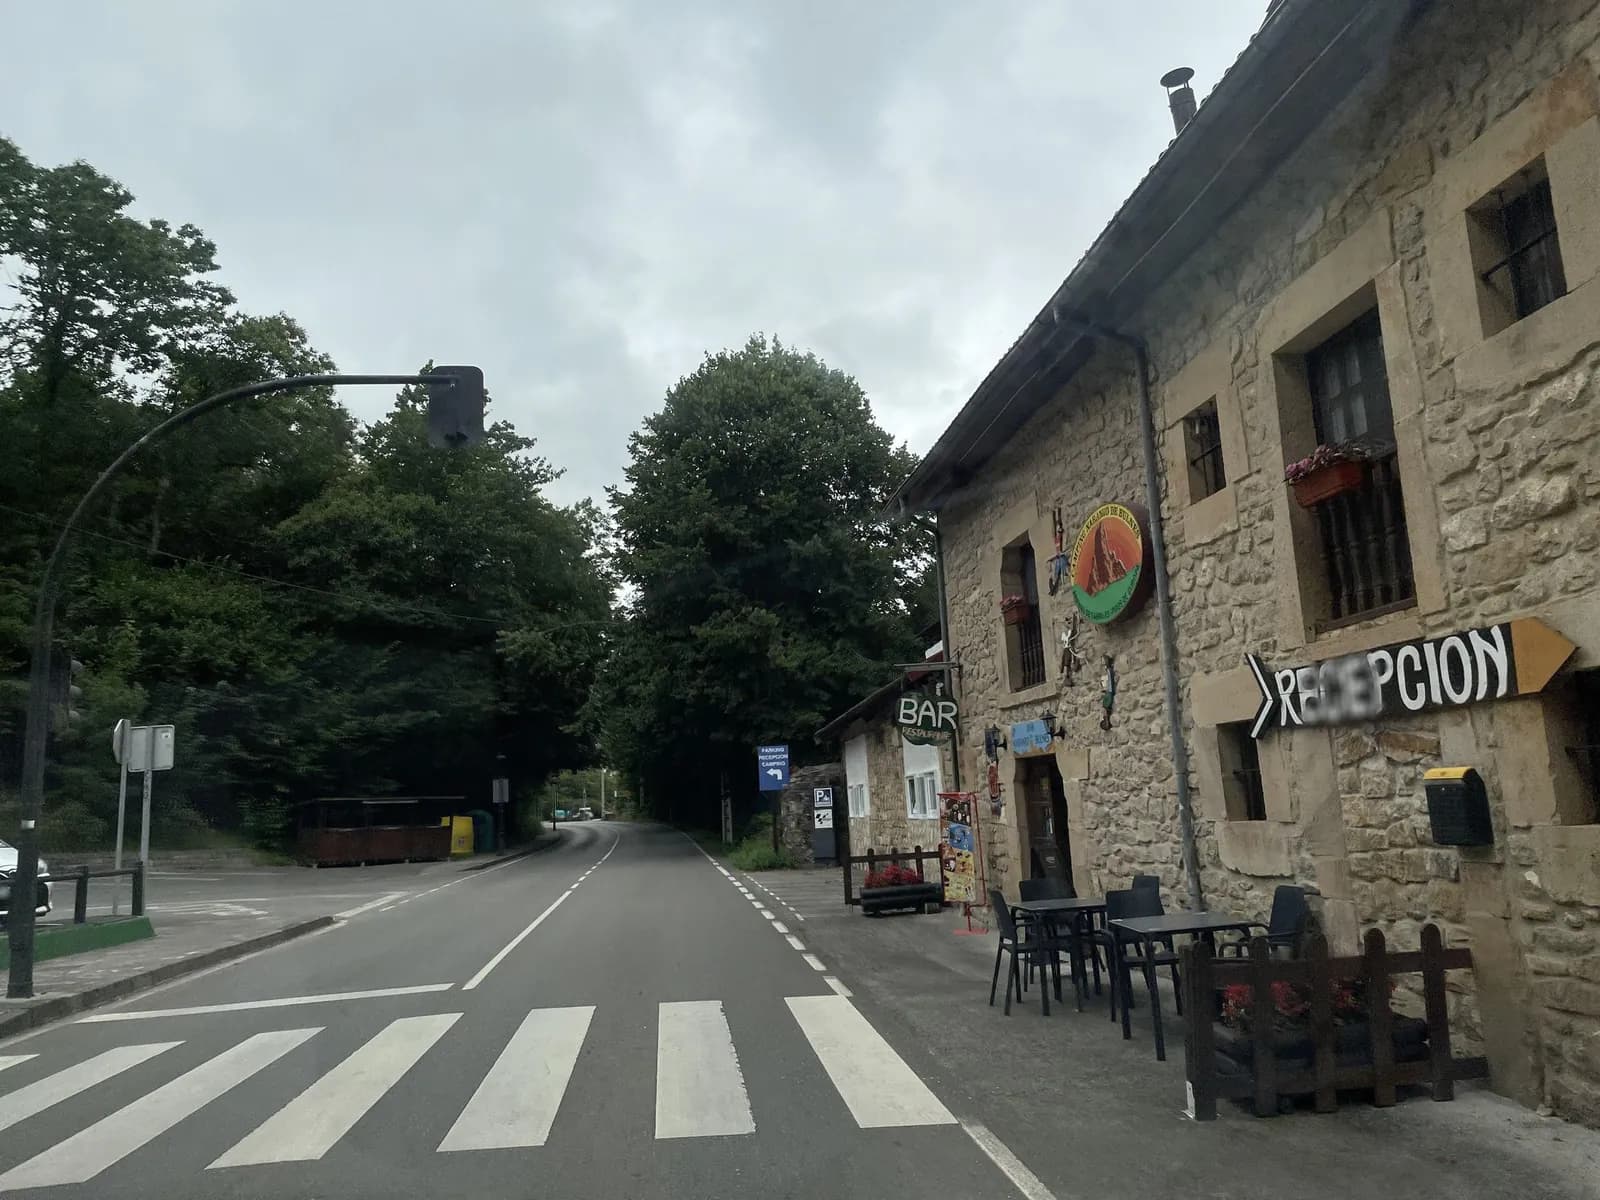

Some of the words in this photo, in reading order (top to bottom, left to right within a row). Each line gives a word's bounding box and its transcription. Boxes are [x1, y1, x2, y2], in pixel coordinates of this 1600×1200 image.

[1274, 624, 1508, 726] REPCION
[898, 698, 957, 729] BAR
[816, 790, 824, 802] P
